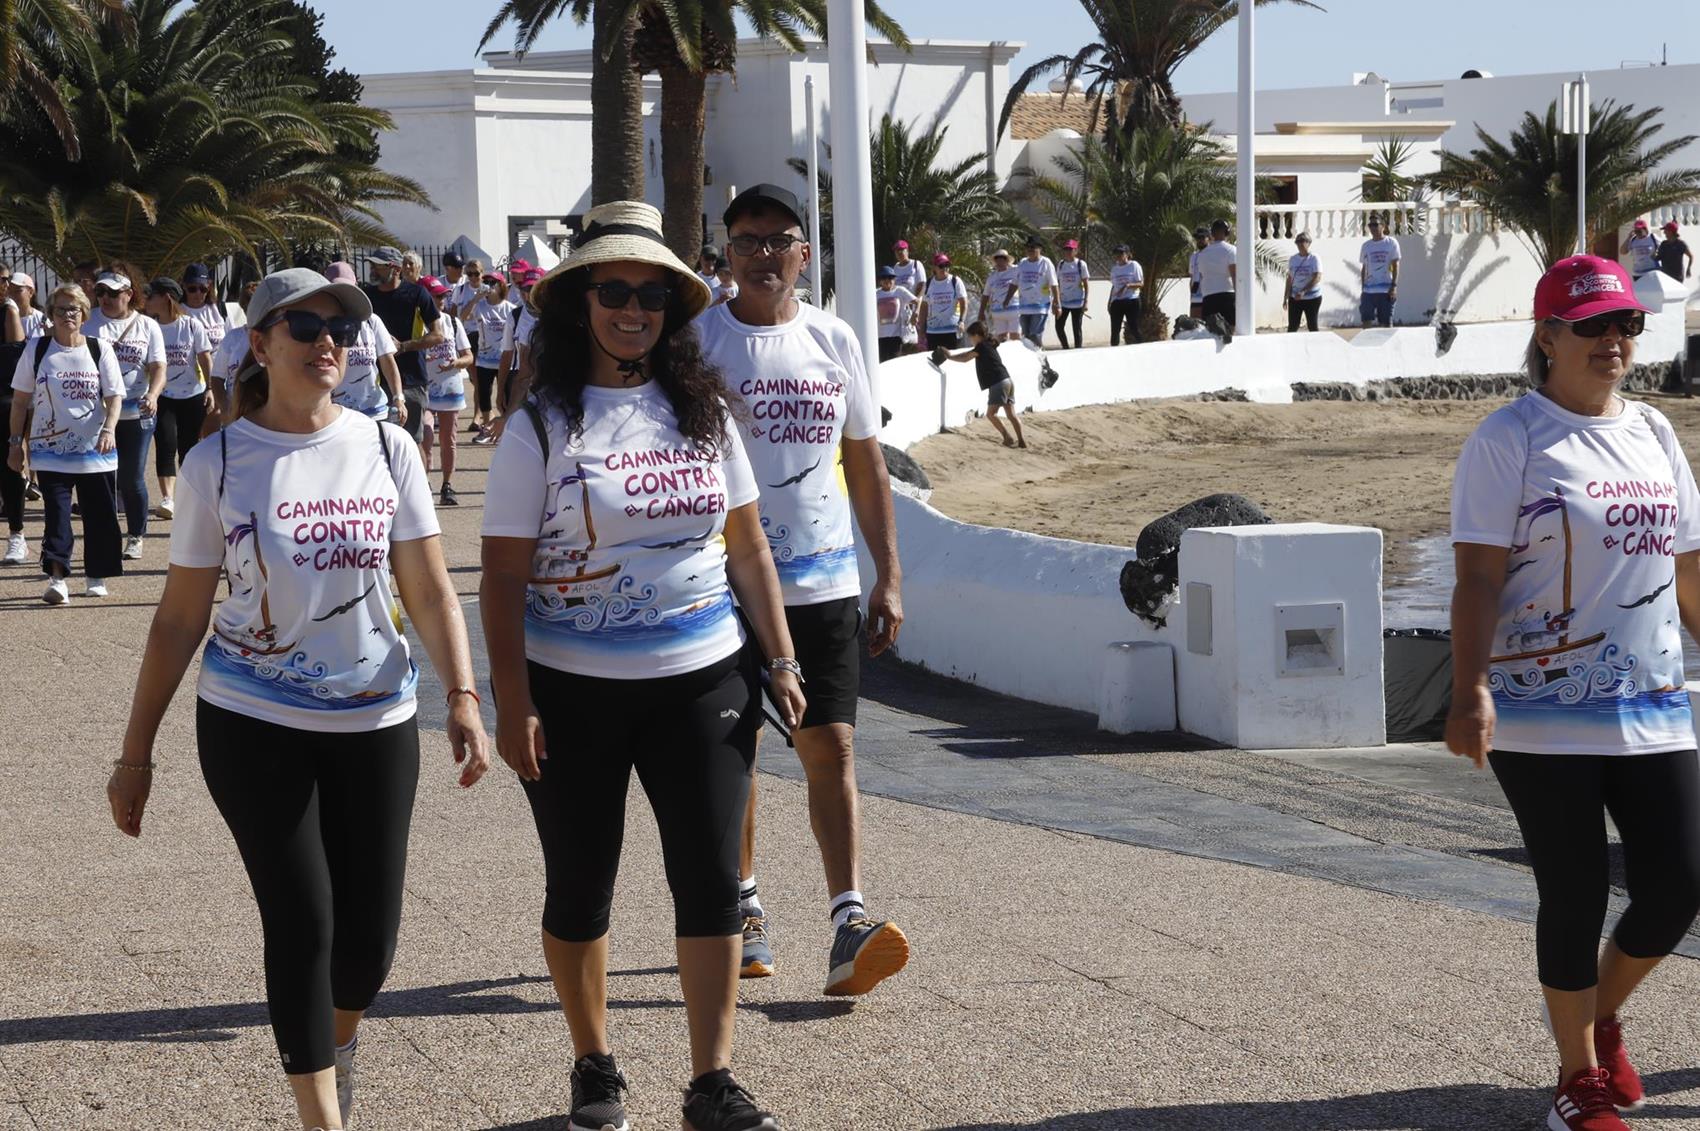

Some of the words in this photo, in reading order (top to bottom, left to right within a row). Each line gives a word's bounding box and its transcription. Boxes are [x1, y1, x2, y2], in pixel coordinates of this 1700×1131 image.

[740, 379, 842, 397] CAMINAMOS
[753, 400, 835, 420] CONTRA
[751, 425, 765, 439] EL
[624, 467, 720, 496] CONTRA
[277, 497, 394, 519] CAMINAMOS
[624, 504, 643, 518] EL
[646, 493, 725, 520] CÁNCER
[1605, 503, 1678, 528] CONTR
[294, 520, 385, 544] CONTRA
[1602, 535, 1619, 550] EL
[292, 552, 311, 567] EL
